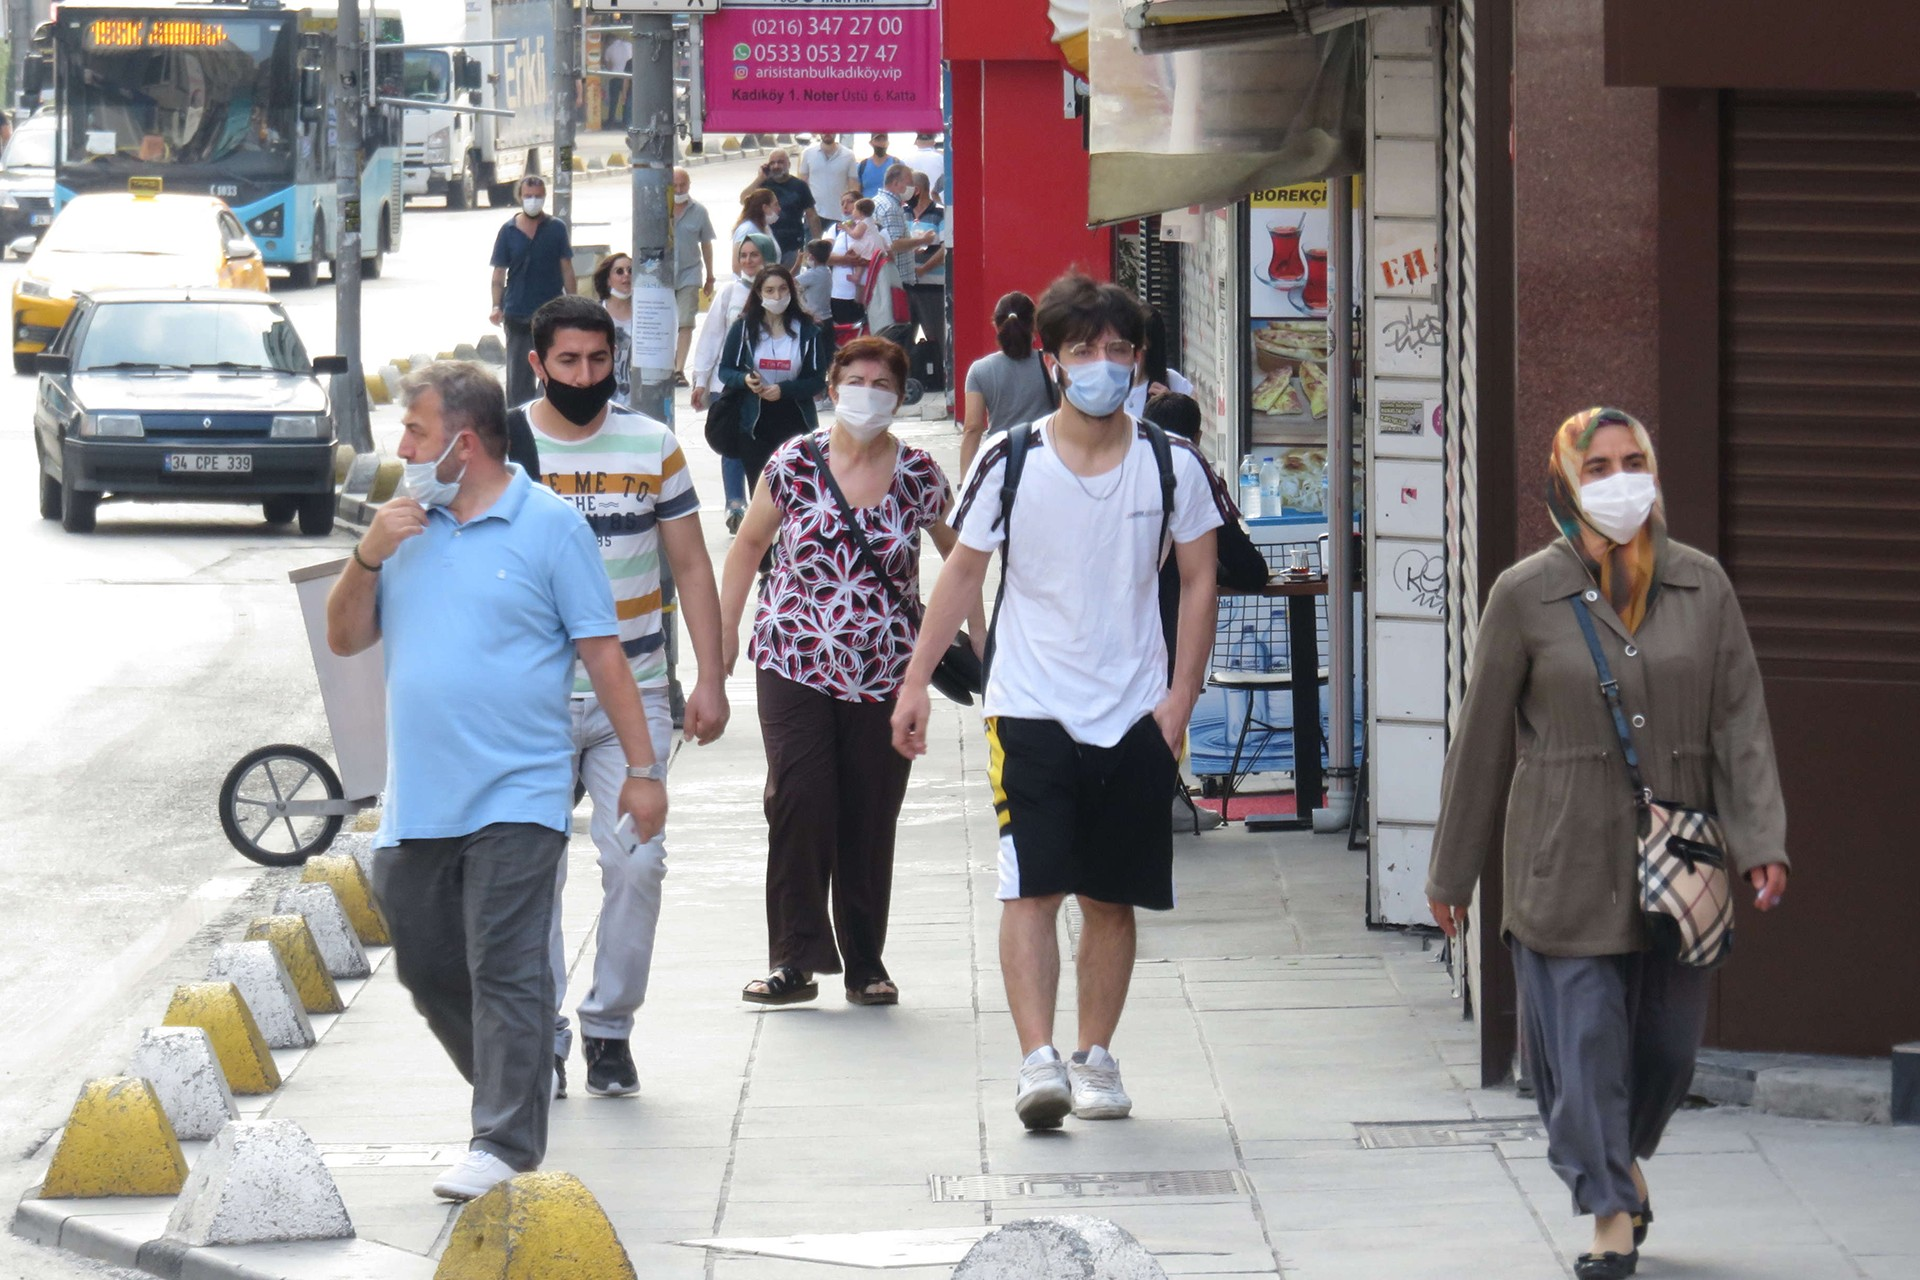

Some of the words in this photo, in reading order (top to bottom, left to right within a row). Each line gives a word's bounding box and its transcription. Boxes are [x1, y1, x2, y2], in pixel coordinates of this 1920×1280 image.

[752, 19, 802, 37] (0216)
[807, 17, 843, 35] 347
[849, 17, 872, 35] 27
[878, 17, 902, 35] 00
[754, 45, 800, 62] 0533
[806, 45, 841, 62] 053
[847, 45, 869, 62] 27
[875, 45, 898, 62] 47
[732, 88, 784, 104] Kadıköy
[788, 89, 799, 101] 1.
[803, 89, 839, 101] Noter
[842, 88, 868, 101] Üstü
[886, 90, 916, 101] Katta
[173, 456, 187, 470] 34
[196, 456, 219, 470] CPE
[228, 456, 250, 470] 339
[575, 471, 607, 494] ME
[622, 475, 650, 502] TO
[563, 495, 596, 512] HE
